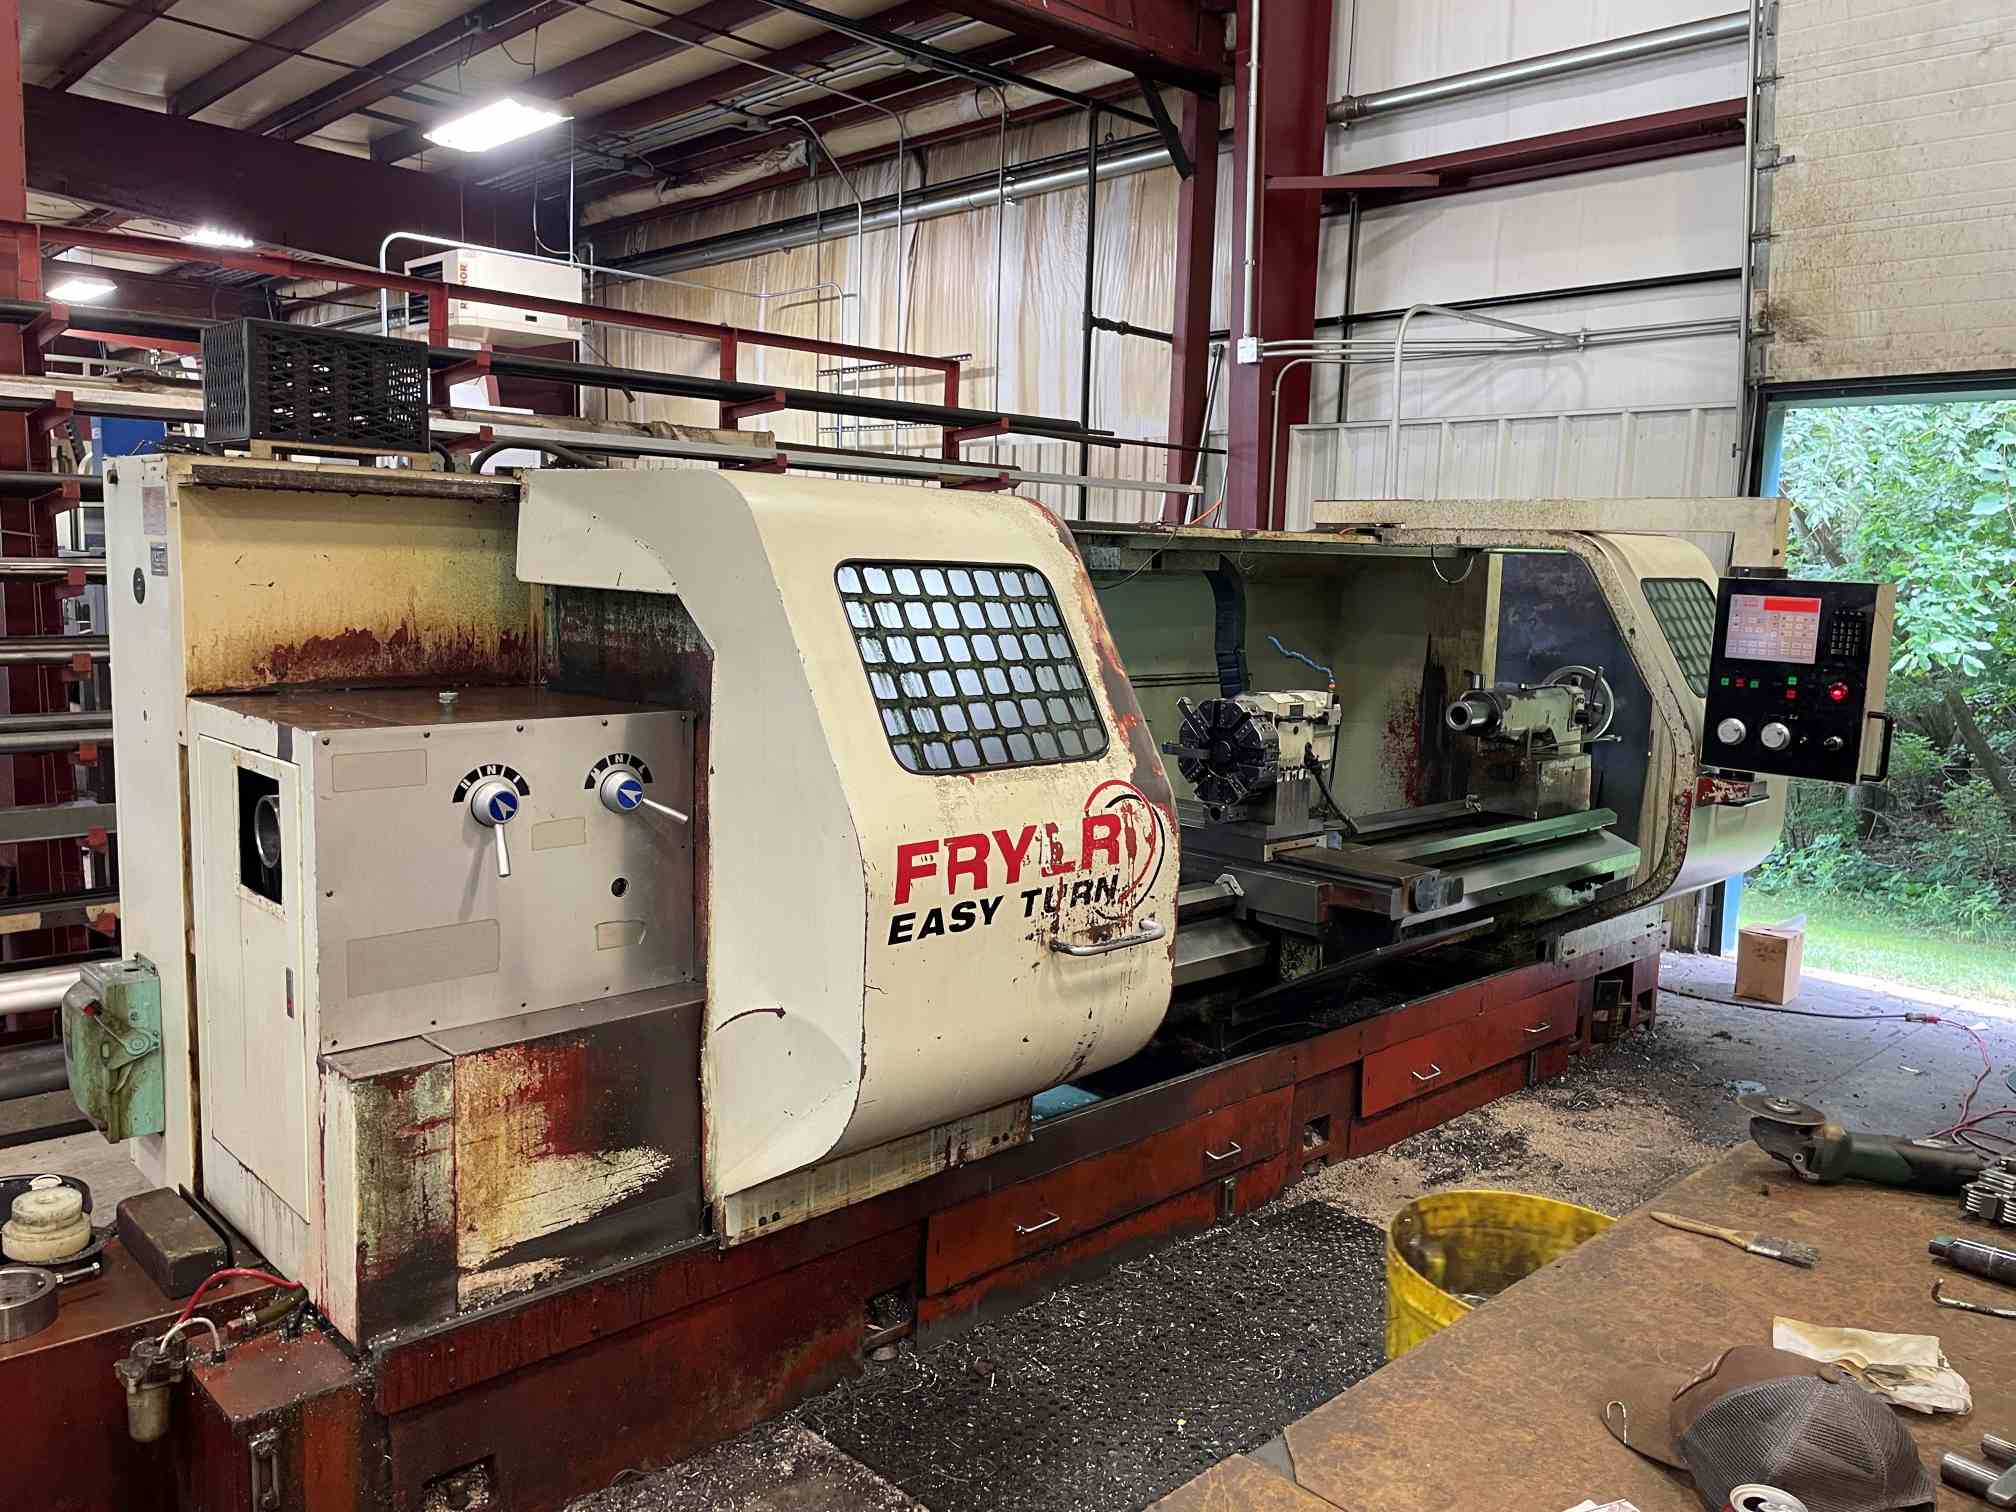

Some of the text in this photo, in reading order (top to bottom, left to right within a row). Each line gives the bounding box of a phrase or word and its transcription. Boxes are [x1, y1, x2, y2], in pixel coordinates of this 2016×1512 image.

[614, 754, 623, 763] N
[486, 765, 497, 775] N
[887, 873, 1120, 946] EASY TURN
